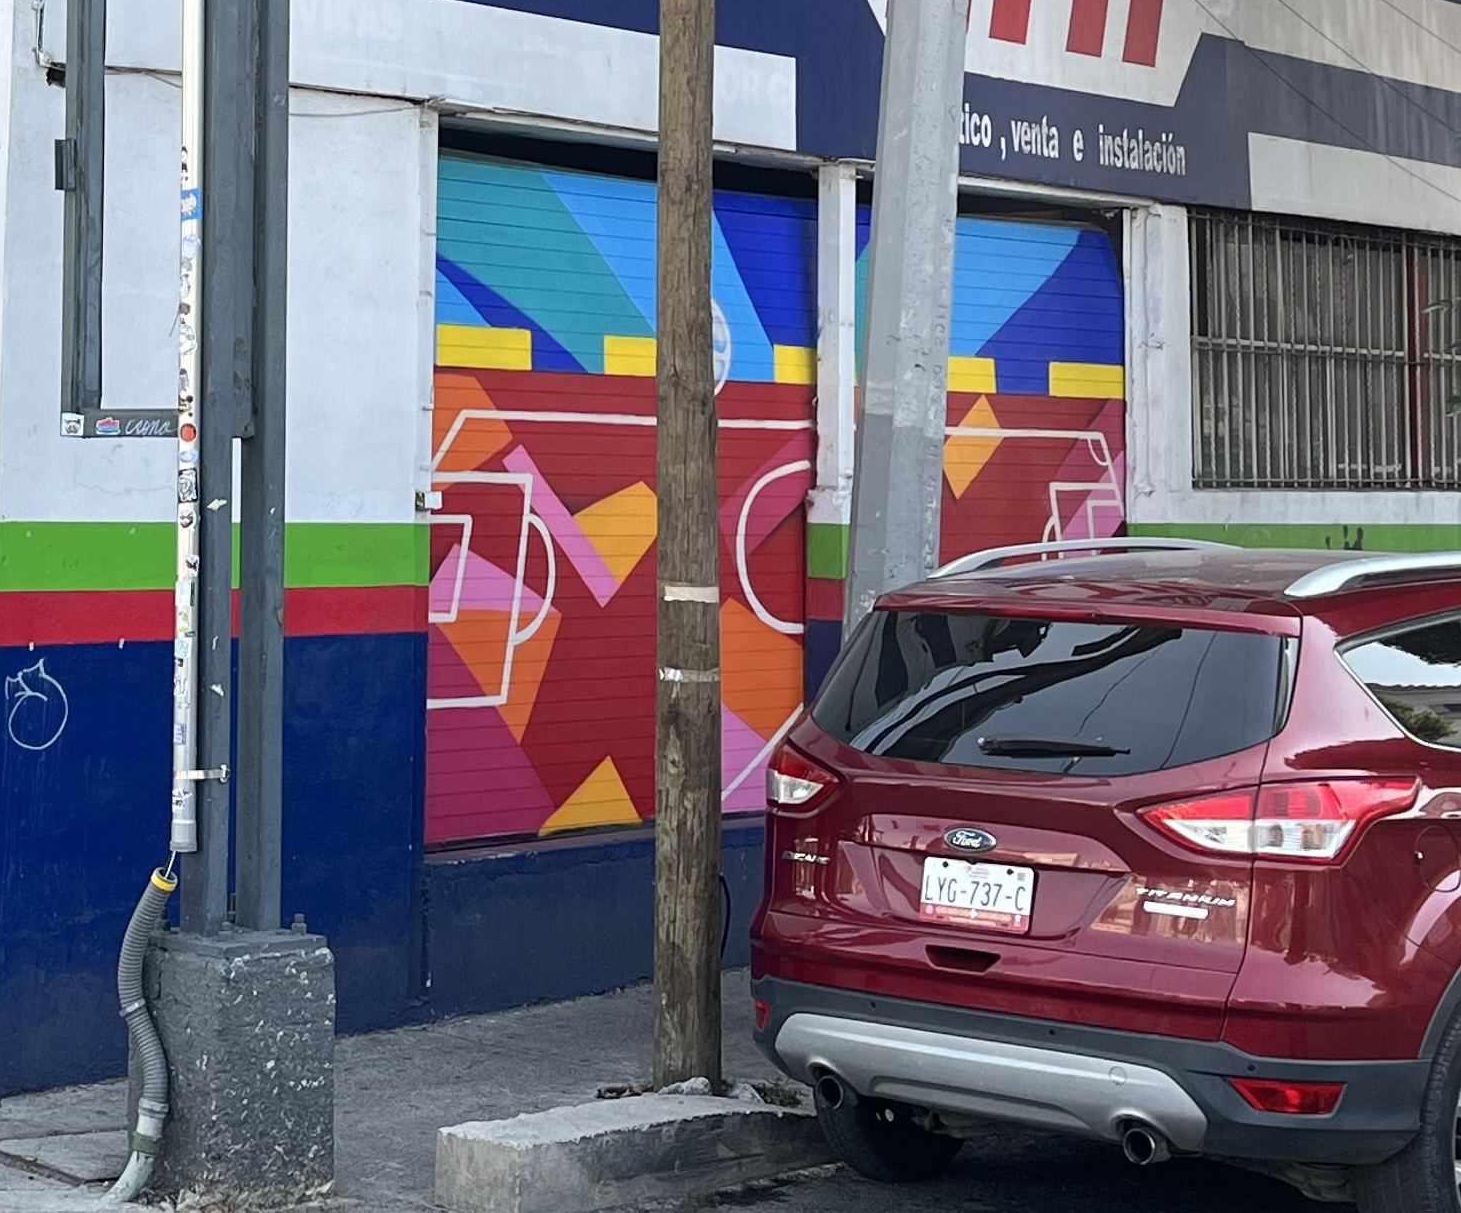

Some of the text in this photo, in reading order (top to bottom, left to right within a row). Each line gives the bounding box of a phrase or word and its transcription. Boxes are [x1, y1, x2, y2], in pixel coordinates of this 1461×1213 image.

[1011, 114, 1060, 160] venta
[1072, 129, 1085, 162] e
[1098, 123, 1188, 177] instalación
[952, 830, 983, 848] Ford
[924, 874, 1027, 912] LYG-737-C
